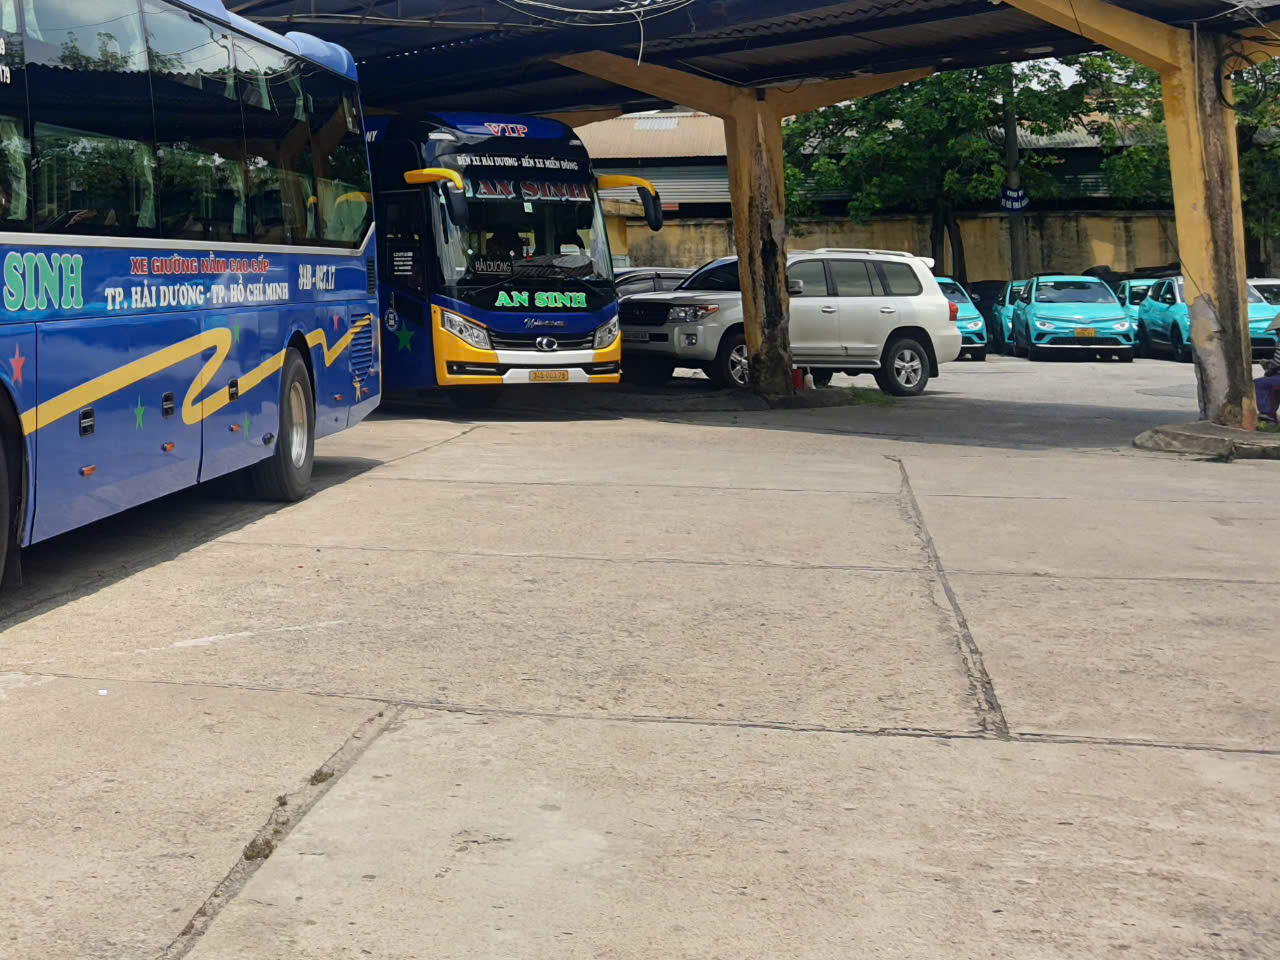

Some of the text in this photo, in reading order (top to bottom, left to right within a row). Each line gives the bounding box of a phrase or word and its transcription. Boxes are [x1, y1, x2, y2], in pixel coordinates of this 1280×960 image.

[484, 123, 528, 137] VIP
[457, 153, 471, 166] BẾN
[471, 156, 481, 166] XE
[481, 154, 494, 166] HẢI
[494, 156, 519, 167] DƯƠNG
[522, 155, 535, 168] BẾN
[535, 159, 545, 168] XE
[476, 180, 591, 202] AN SINH
[130, 251, 270, 275] XE GIƯỜNG NẰM CAO CẤP
[3, 251, 84, 312] SINH
[104, 287, 128, 310] TP.
[131, 278, 157, 309] HẢI
[160, 282, 205, 307] DƯƠNG
[230, 274, 245, 303] HỒ
[247, 276, 265, 302] CHÍ
[266, 282, 289, 301] MINH
[494, 291, 587, 308] AN SINH
